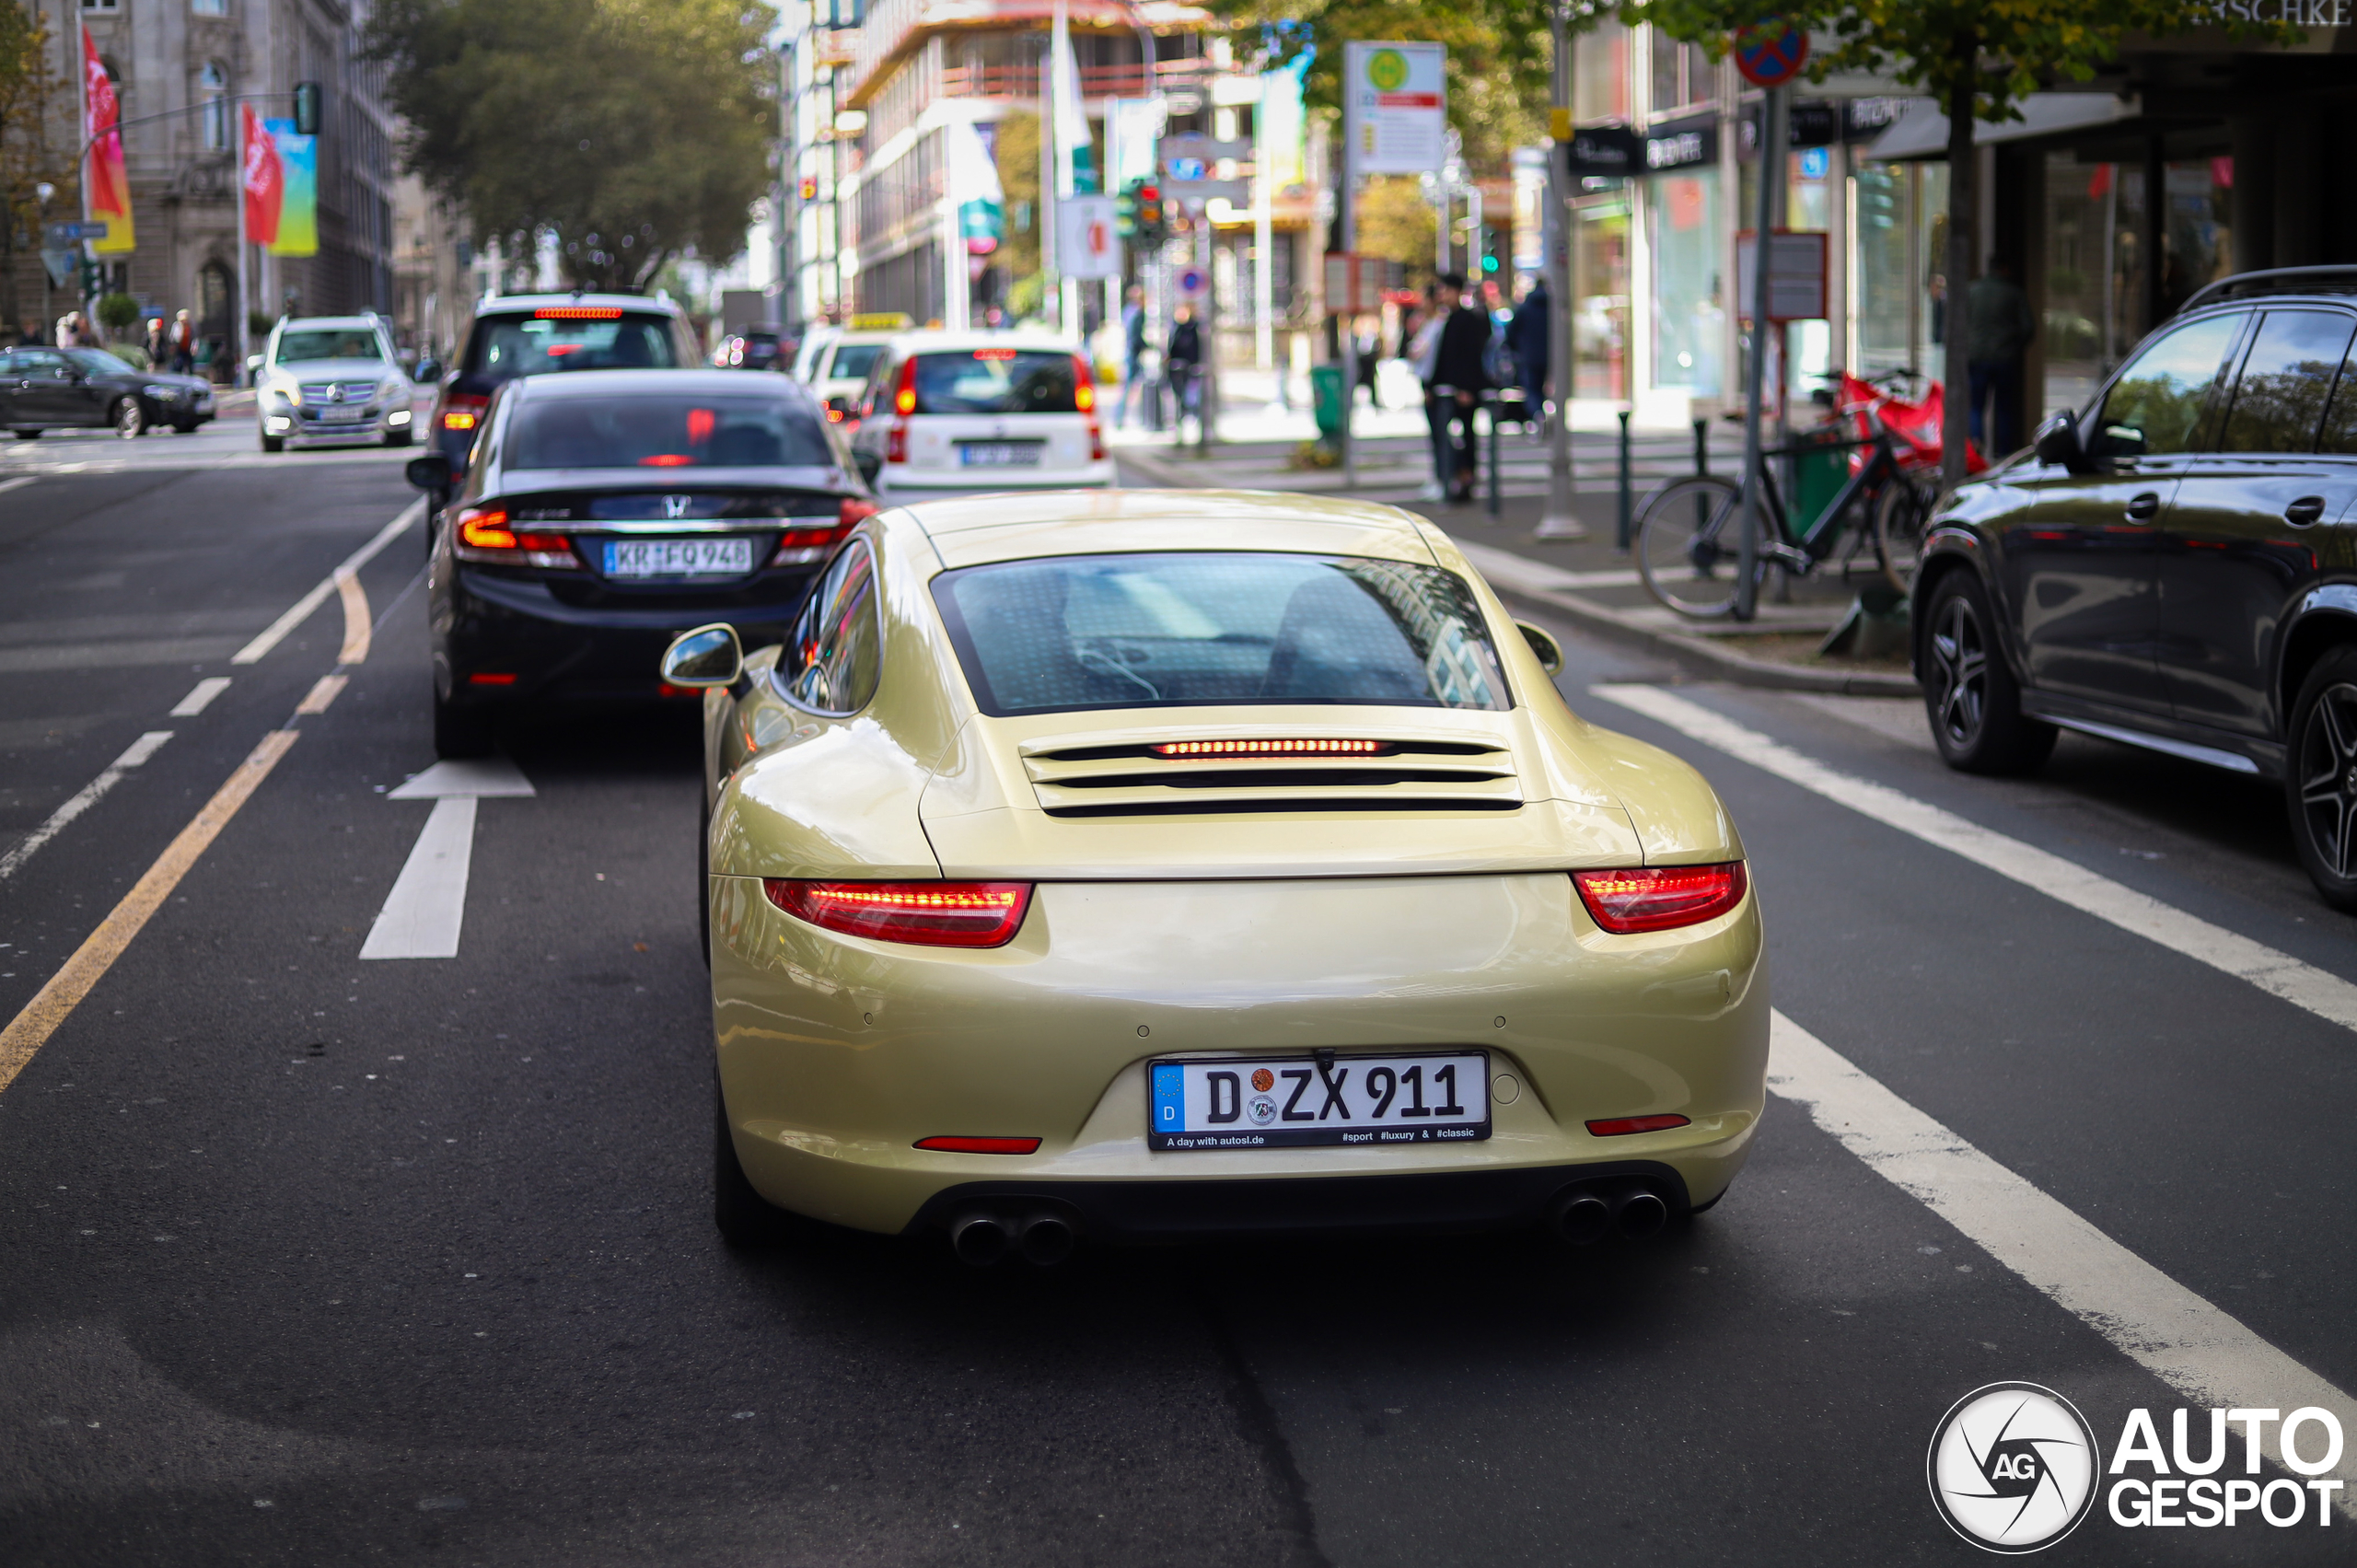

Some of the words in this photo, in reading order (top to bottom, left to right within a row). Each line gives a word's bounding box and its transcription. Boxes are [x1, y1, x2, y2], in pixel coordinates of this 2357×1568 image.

[618, 543, 649, 567] KR
[702, 541, 747, 565] 948
[1206, 1070, 1241, 1123] D
[1281, 1066, 1351, 1121] ZX
[1365, 1063, 1465, 1119] 911
[1163, 1106, 1176, 1121] D
[1167, 1137, 1175, 1146] A
[1177, 1137, 1194, 1148] day
[1197, 1136, 1217, 1145] with
[1219, 1135, 1265, 1145] autosl.de
[1342, 1132, 1373, 1143] #sport
[1381, 1131, 1415, 1141] #luxury
[1422, 1130, 1430, 1139] &
[1436, 1128, 1475, 1138] #classic
